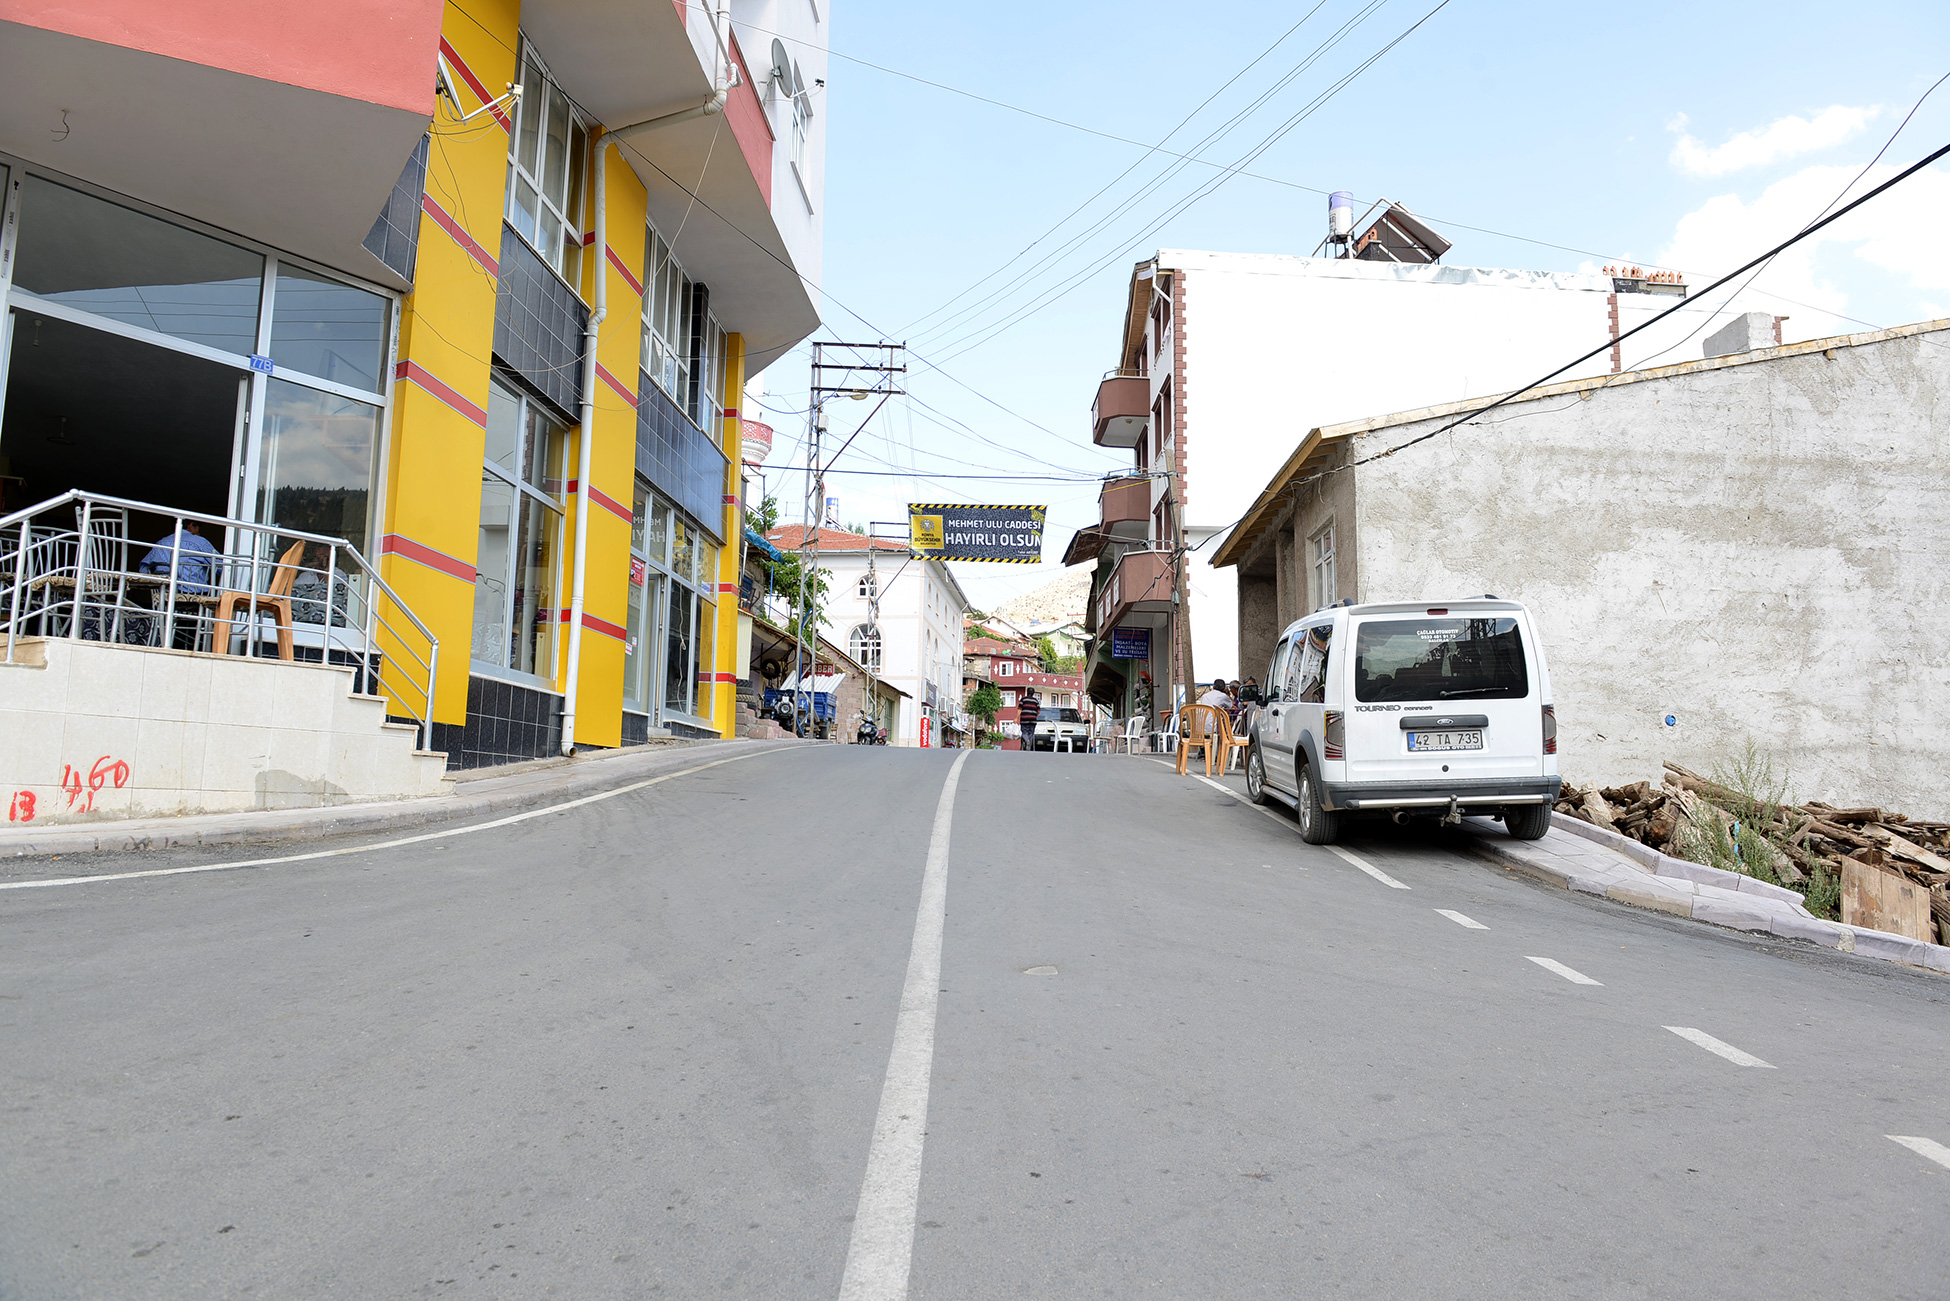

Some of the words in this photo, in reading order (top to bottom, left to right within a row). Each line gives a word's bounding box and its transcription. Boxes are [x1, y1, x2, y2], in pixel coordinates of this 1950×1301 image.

[251, 356, 271, 371] 77B
[948, 519, 984, 529] MEHMET
[986, 520, 1002, 529] ULU
[1004, 519, 1041, 529] CADDESİ
[945, 532, 996, 546] HAYIRLI
[1000, 533, 1041, 547] OLSUN
[1354, 704, 1401, 713] TOURNEO
[1415, 734, 1430, 746] 42
[1437, 733, 1451, 745] TA
[1457, 732, 1479, 745] 735
